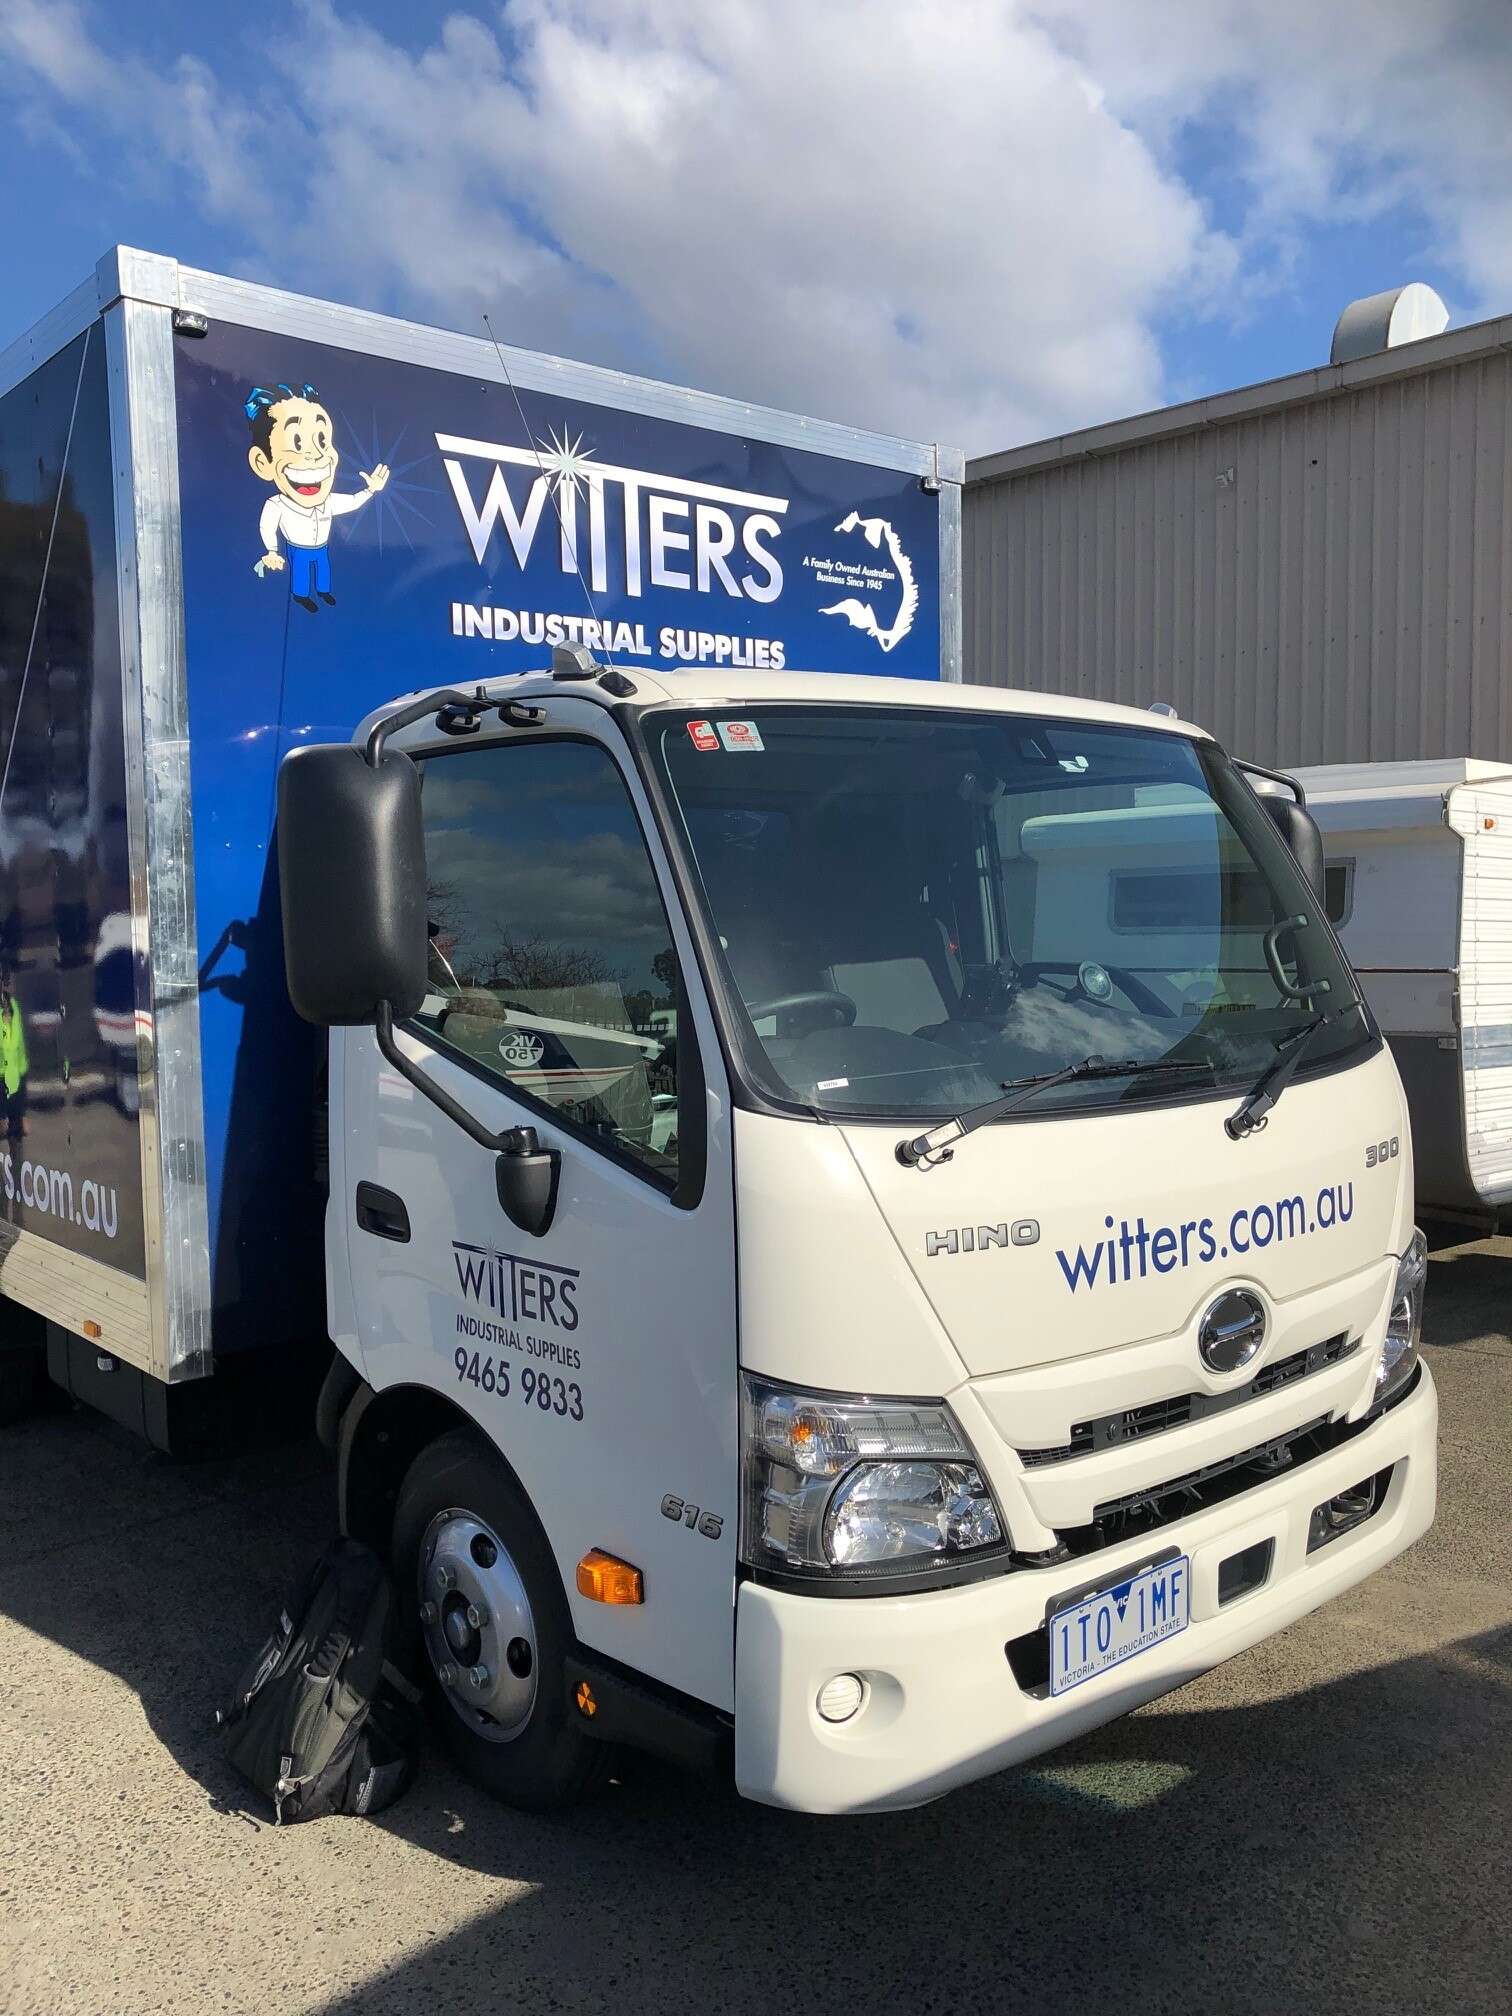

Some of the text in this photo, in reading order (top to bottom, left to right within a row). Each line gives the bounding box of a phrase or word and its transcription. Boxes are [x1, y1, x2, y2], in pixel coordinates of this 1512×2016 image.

[435, 432, 790, 603] WITTERS
[802, 556, 895, 580] A Family Owned Australian
[816, 571, 883, 591] Business Since 1945
[452, 603, 786, 670] INDUSTRIAL SUPPLIES
[1365, 1136, 1399, 1168] 300
[926, 1218, 1040, 1257] HINO
[1056, 1181, 1354, 1295] witters.com.au
[452, 1240, 580, 1331] WITTERS
[456, 1314, 581, 1369] INDUSTRIAL SUPPLIES
[454, 1346, 584, 1421] 9465 9833
[661, 1493, 724, 1540] 616
[1059, 1662, 1095, 1687] VICTORIA
[1102, 1650, 1117, 1665] THE
[1118, 1631, 1159, 1656] EDUCATION
[1160, 1618, 1182, 1635] STATE
